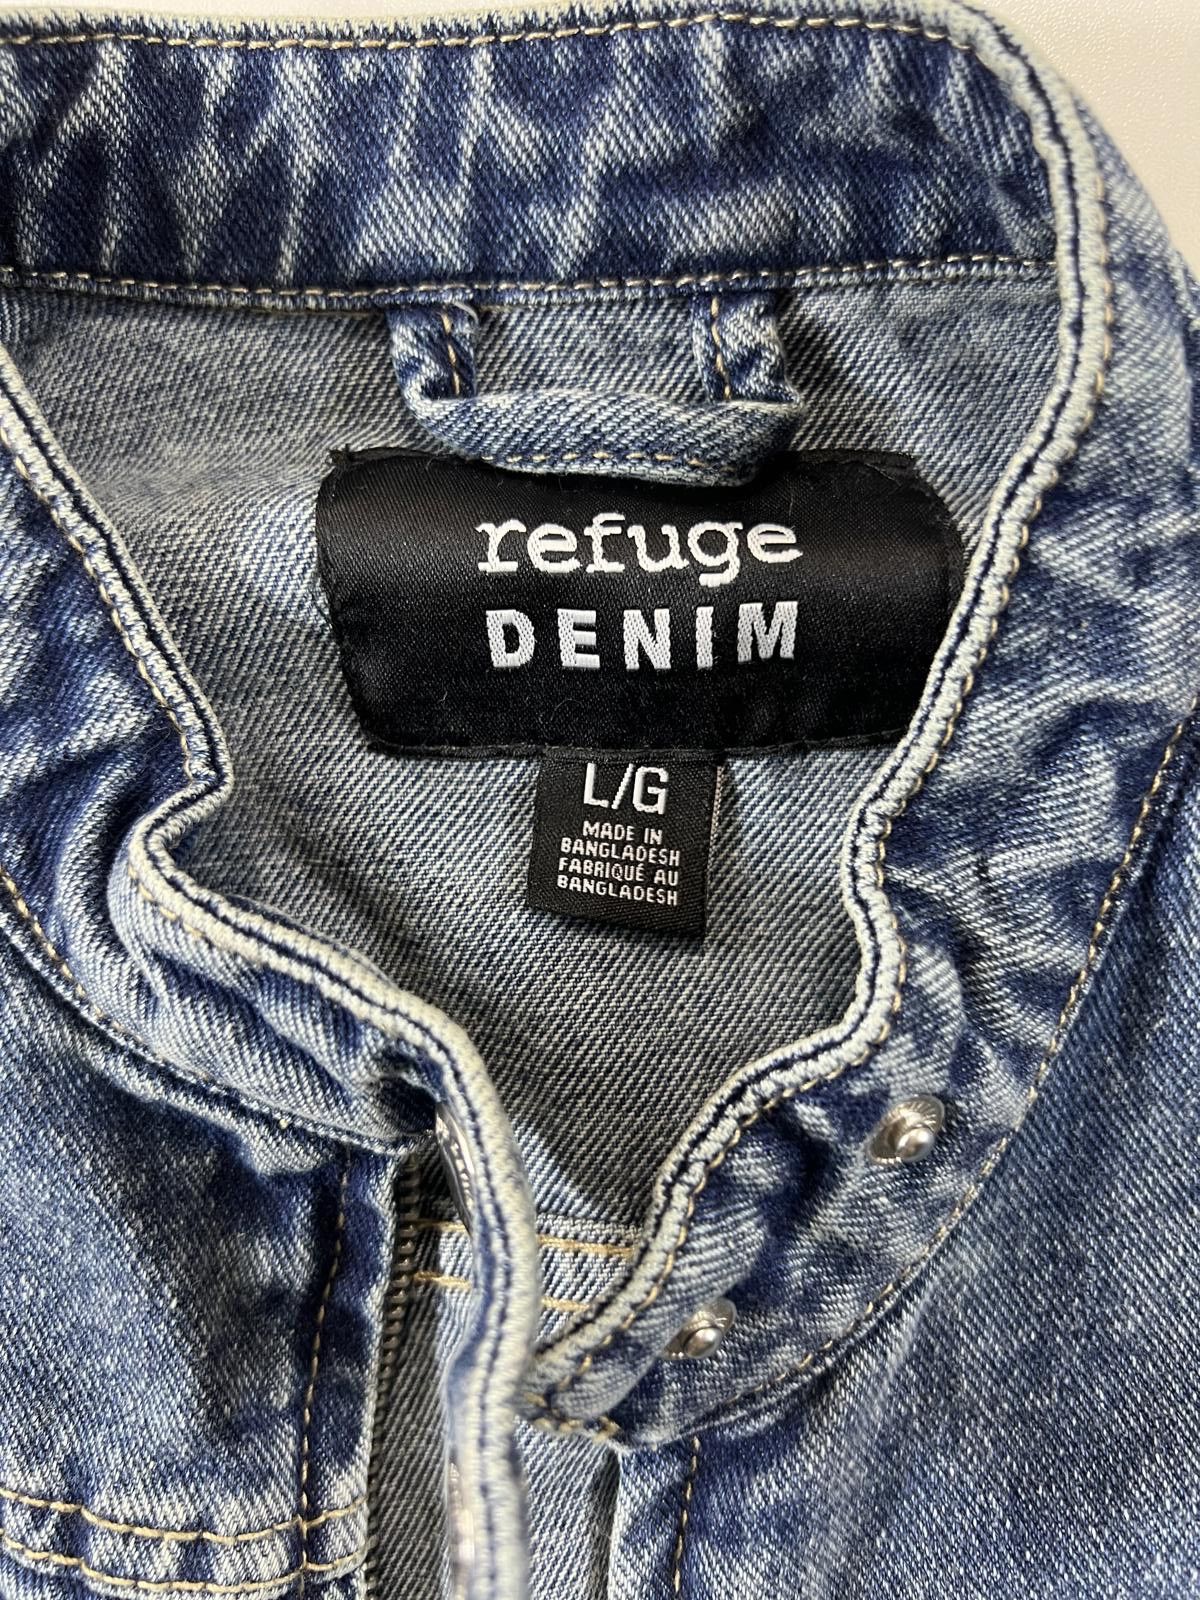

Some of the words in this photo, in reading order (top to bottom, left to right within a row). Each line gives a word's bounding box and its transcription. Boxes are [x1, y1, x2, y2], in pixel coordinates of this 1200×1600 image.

[475, 512, 803, 588] refuge
[485, 601, 798, 670] DENIM
[583, 762, 669, 815] L/G
[582, 820, 635, 841] MADE
[644, 827, 663, 845] IN
[560, 837, 681, 866] BANGLADESH
[558, 857, 645, 882] FABRIQUÉ
[653, 869, 679, 887] AU
[557, 874, 678, 906] BANGLADESH
